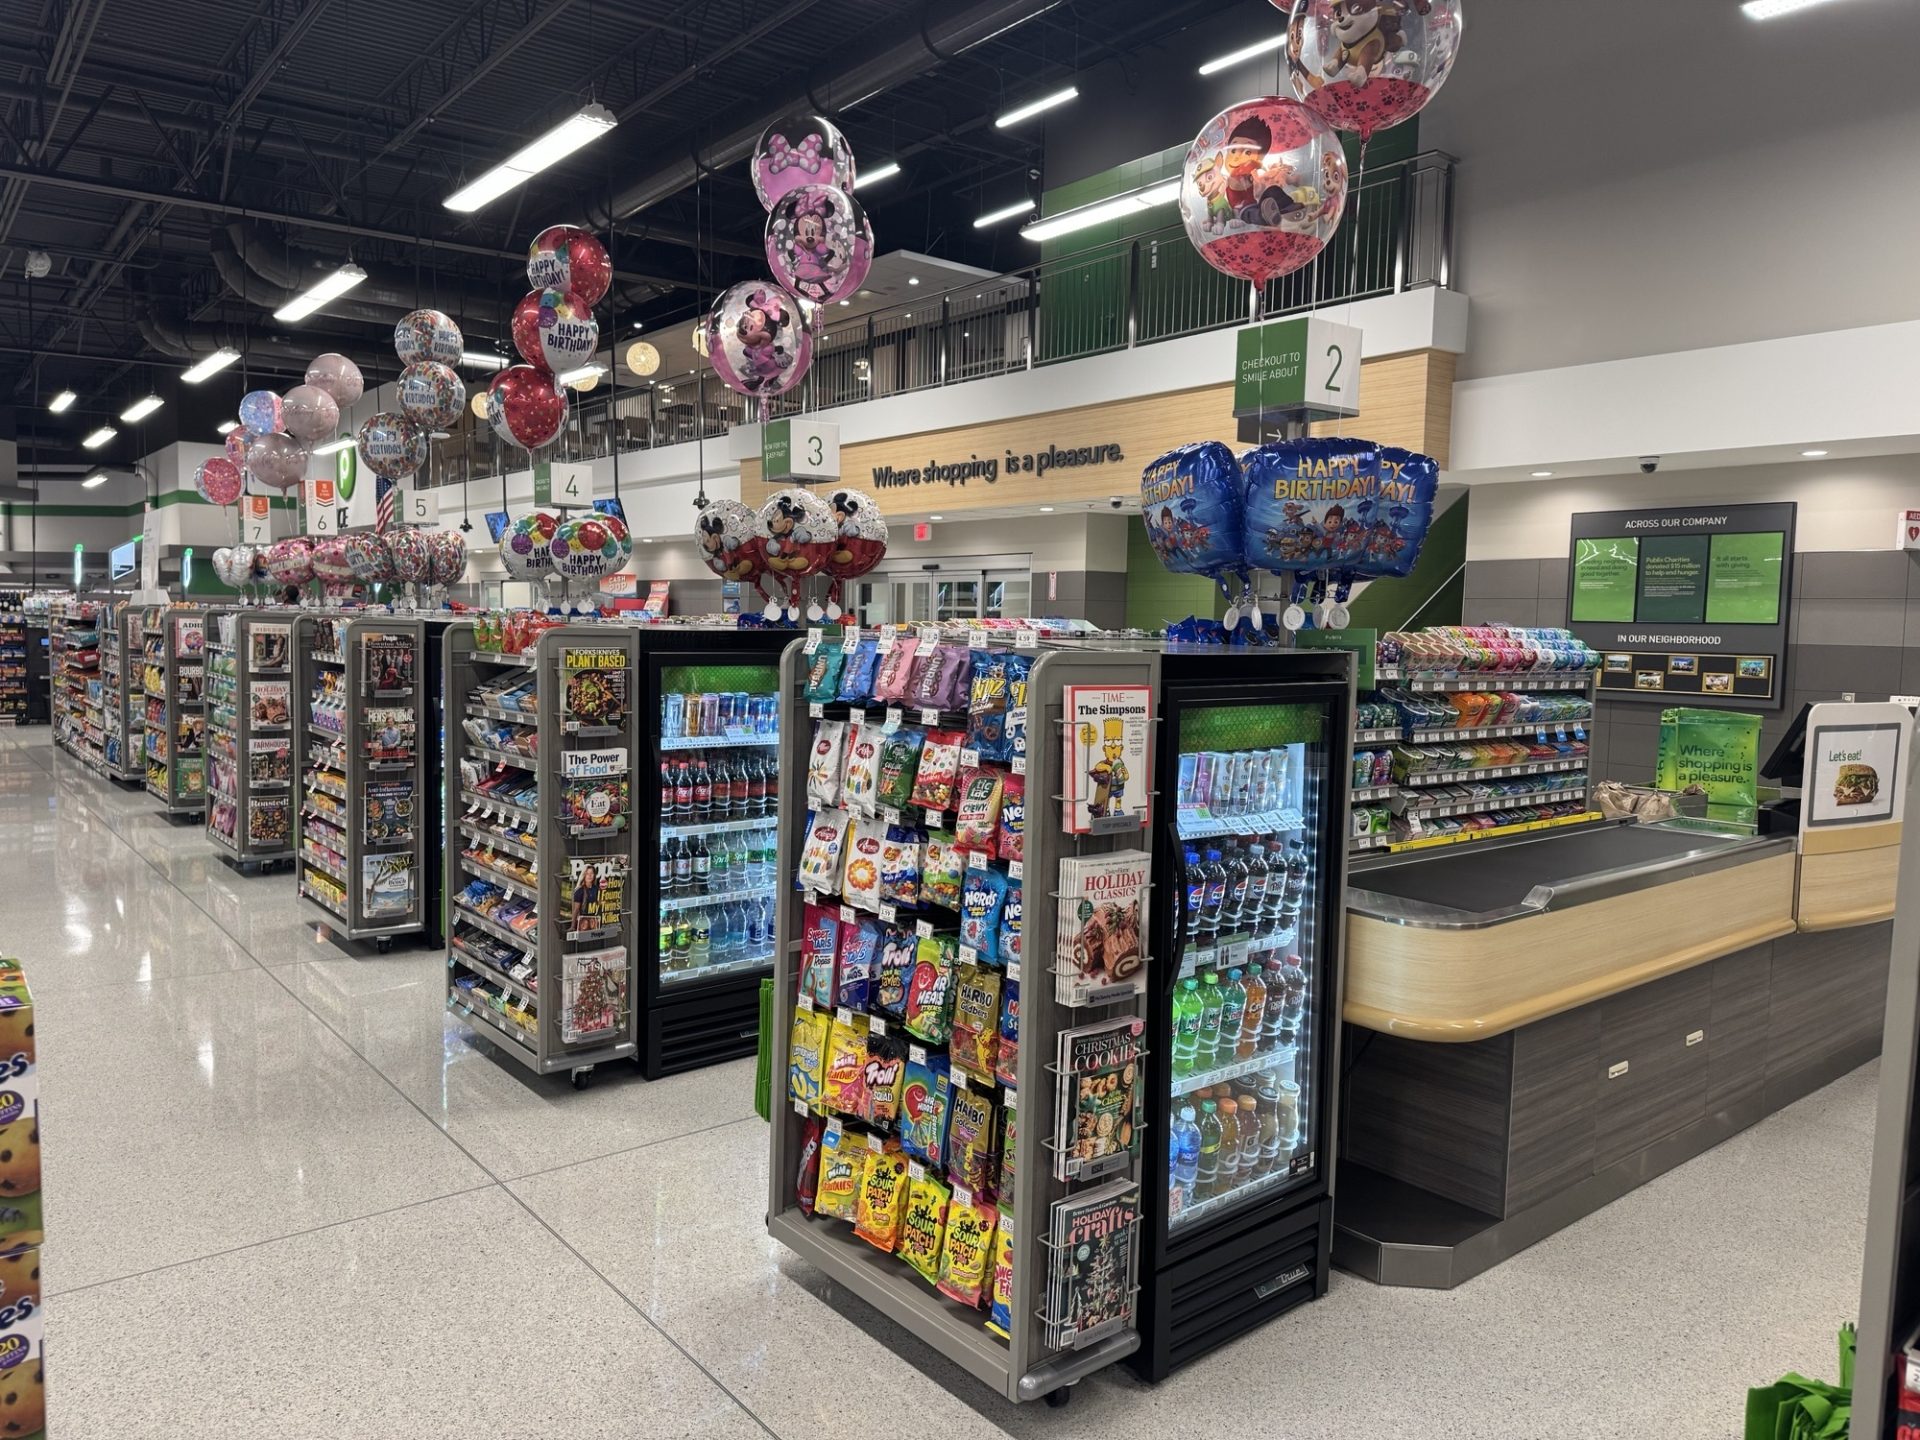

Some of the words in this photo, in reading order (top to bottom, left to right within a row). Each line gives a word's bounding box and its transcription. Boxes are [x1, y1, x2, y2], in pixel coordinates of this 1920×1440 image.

[558, 322, 589, 338] HAPPY
[548, 334, 593, 353] BIRTHDAY!
[1242, 354, 1287, 371] CHECKOUT
[1290, 352, 1301, 362] TO
[1325, 344, 1342, 392] 2
[1242, 371, 1268, 384] SMILE
[1269, 366, 1299, 380] ABOUT
[808, 436, 823, 466] 3
[872, 467, 920, 488] Where
[922, 454, 998, 487] shopping
[1005, 450, 1019, 473] is
[1022, 454, 1033, 471] a
[1036, 442, 1125, 477] pleasure.
[1297, 458, 1360, 477] HAPPY
[565, 474, 579, 497] 4
[1275, 476, 1376, 500] BIRTHDAY!
[416, 499, 426, 517] 5
[318, 515, 327, 531] 6
[1625, 519, 1659, 529] ACROSS
[1661, 519, 1680, 527] OUR
[1682, 516, 1728, 526] COMPANY
[253, 526, 262, 541] 7
[569, 555, 601, 565] HAPPY
[562, 562, 607, 576] BIRTHDAY!
[608, 575, 626, 585] CASH
[608, 582, 627, 592] POP
[1617, 634, 1627, 643] IN
[1628, 634, 1647, 643] OUR
[1649, 635, 1721, 645] NEIGHBORHOOD
[566, 656, 595, 668] PLANT
[598, 655, 625, 667] BASED
[921, 656, 942, 698] UNREAL
[1102, 692, 1125, 703] TIME
[1078, 704, 1098, 715] The
[1100, 704, 1146, 716] Simpsons
[1680, 744, 1725, 757] Where
[1829, 750, 1847, 762] Let's
[1848, 749, 1862, 761] eat!
[568, 754, 588, 766] The
[590, 753, 620, 764] Power
[1679, 758, 1740, 774] shopping
[1743, 760, 1752, 771] is
[569, 765, 580, 776] of
[583, 764, 608, 775] Food
[1679, 773, 1686, 781] a
[1689, 770, 1747, 784] pleasure.
[608, 877, 624, 888] How
[1085, 871, 1146, 891] HOLIDAY
[602, 890, 621, 899] Found
[1093, 887, 1136, 900] CLASSICS
[588, 903, 599, 915] My
[602, 913, 620, 924] Killer
[882, 942, 912, 966] Trolli
[961, 983, 993, 1008] HARIBO
[1075, 1033, 1131, 1056] CHRISTMAS
[1074, 1041, 1141, 1072] COOKIES
[866, 1061, 899, 1085] Trolli
[955, 1098, 985, 1126] HARIBO
[870, 1174, 895, 1190] SOUR
[867, 1187, 892, 1204] PATCH
[909, 1211, 935, 1235] SOUR
[1069, 1207, 1135, 1245] crafts
[1072, 1208, 1112, 1228] HOLIDAY
[904, 1225, 934, 1250] PATCH
[953, 1227, 980, 1248] SOUR
[949, 1239, 977, 1259] PATCH
